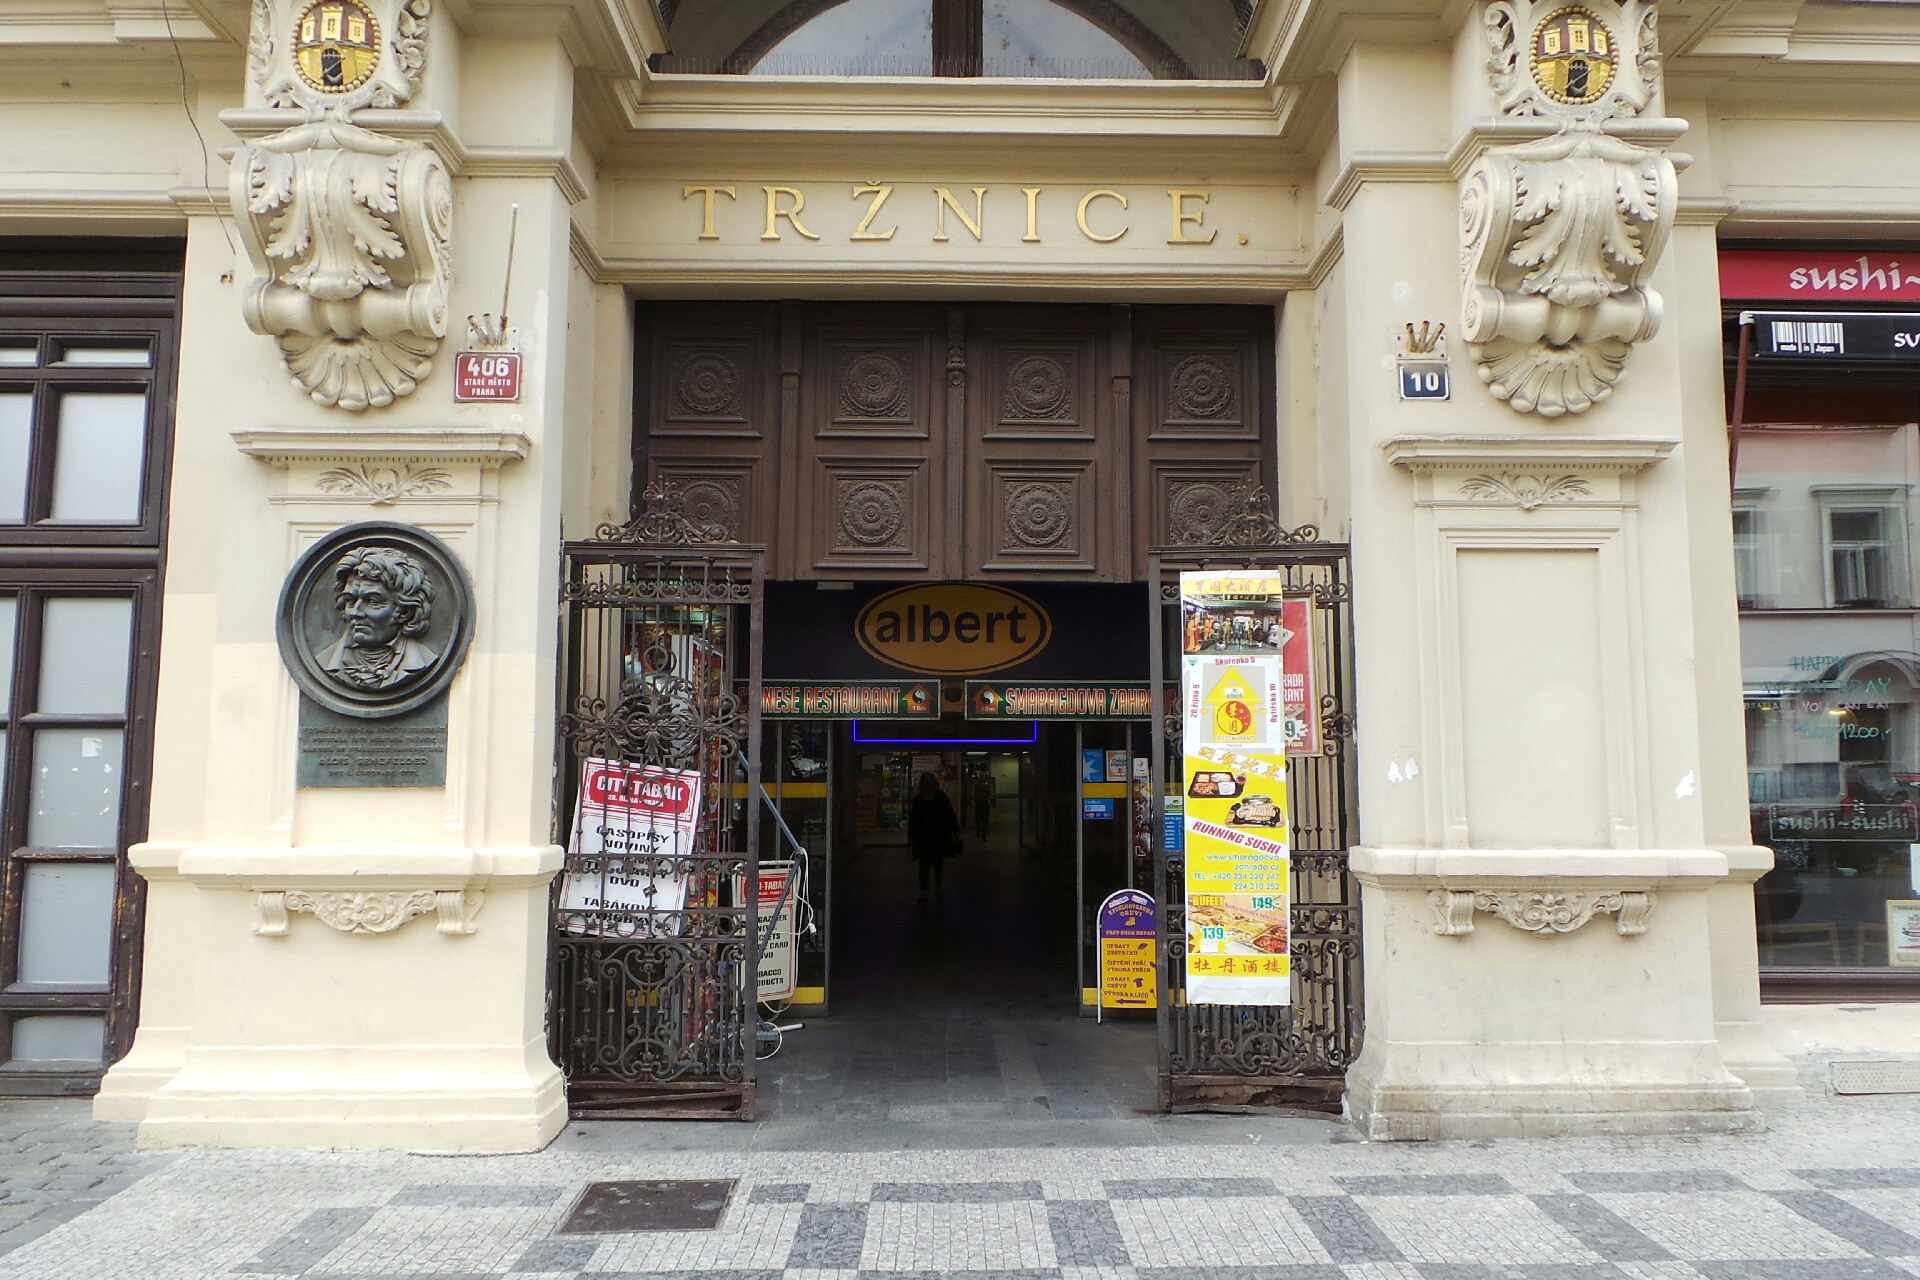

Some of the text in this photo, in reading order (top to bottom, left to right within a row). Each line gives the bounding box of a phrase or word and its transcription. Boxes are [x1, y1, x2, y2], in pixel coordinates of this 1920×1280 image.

[467, 357, 509, 377] 406
[464, 377, 511, 386] STARÉ MĚSTO
[1410, 371, 1440, 392] 10
[471, 388, 503, 396] PRAHA 1
[875, 604, 1027, 644] albert
[1250, 656, 1256, 664] 5
[803, 686, 901, 715] RESTAURANT
[1005, 687, 1107, 715] SMARAGDOVA
[1192, 821, 1245, 845] RUNNING
[1244, 836, 1282, 856] SUSHI
[609, 876, 640, 888] DVD
[1213, 872, 1231, 880] +420
[1233, 882, 1280, 890] 224 210 252
[1192, 895, 1225, 906] BUFFET
[769, 941, 789, 949] CARD
[1194, 957, 1282, 974] 牡丹酒楼
